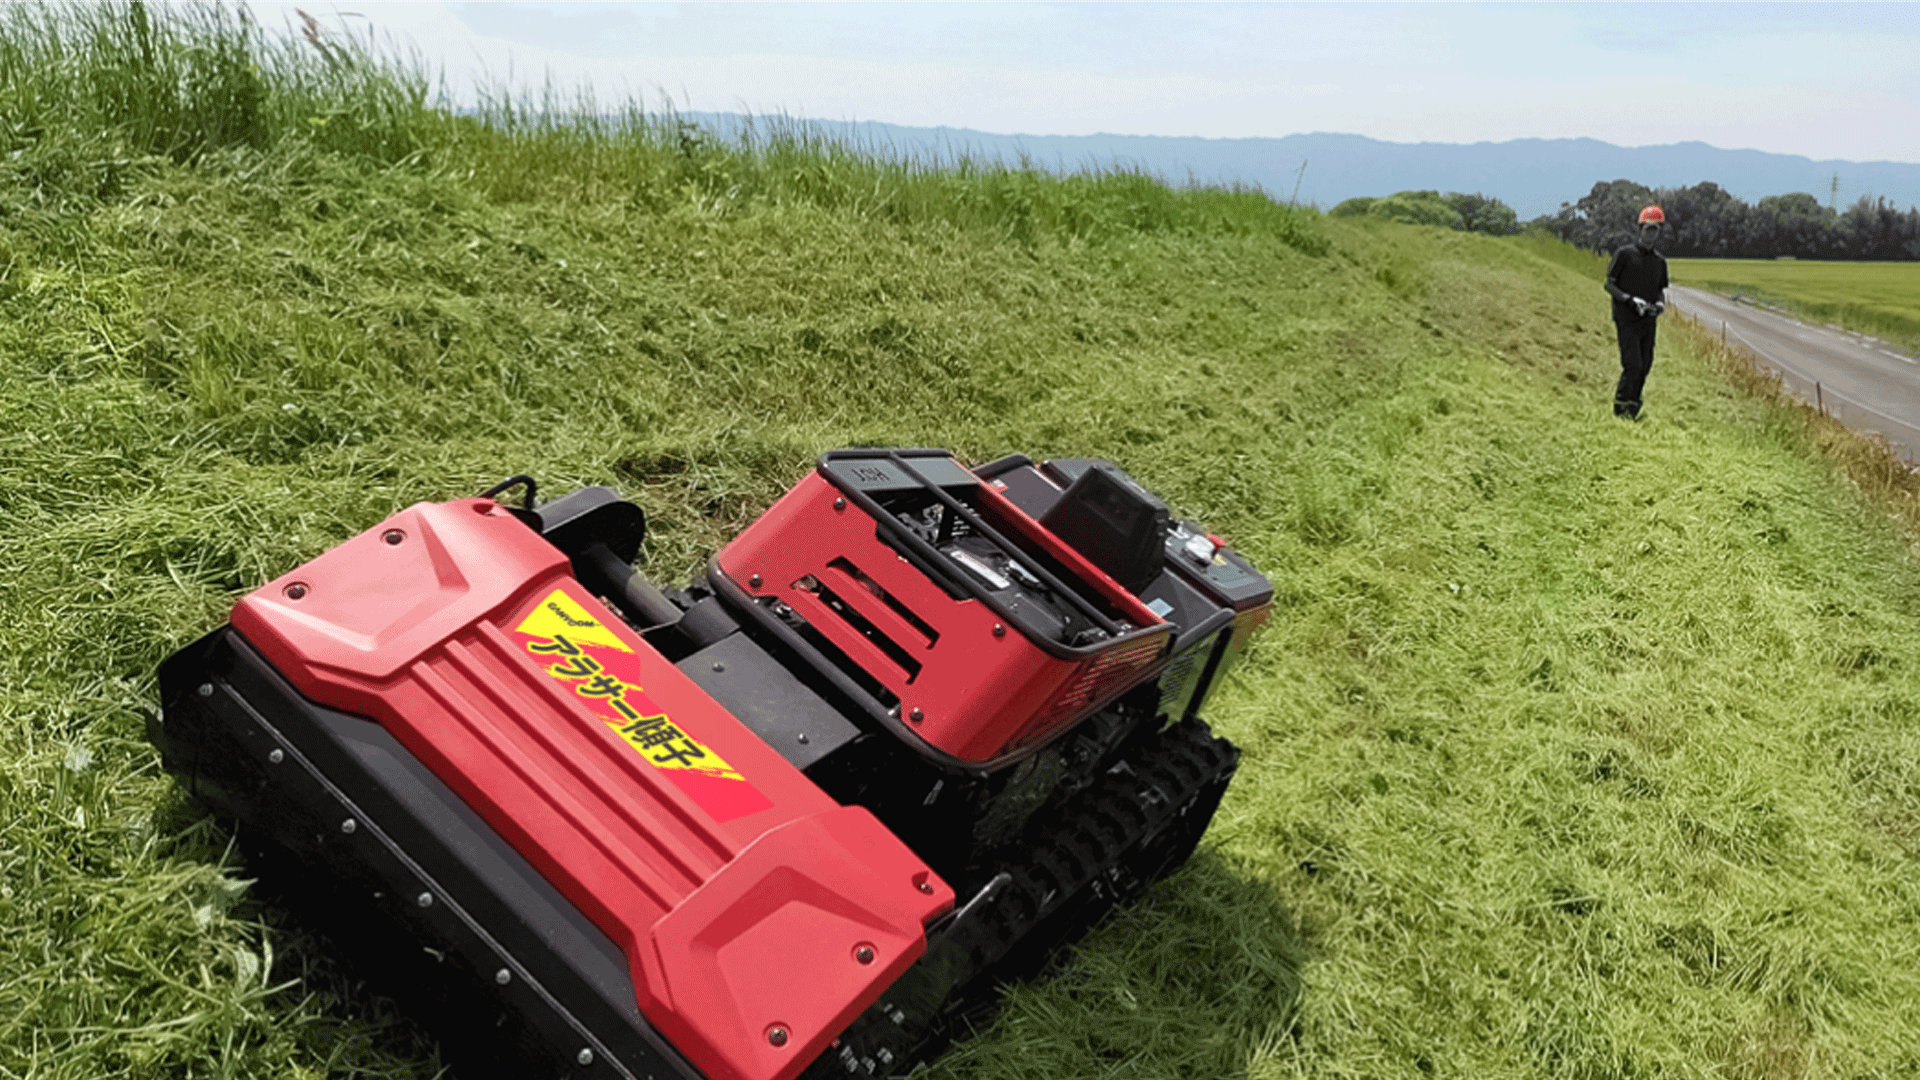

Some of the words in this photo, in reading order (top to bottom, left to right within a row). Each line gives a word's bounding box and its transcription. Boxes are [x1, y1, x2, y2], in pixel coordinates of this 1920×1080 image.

[530, 634, 706, 767] アラサー傾子
